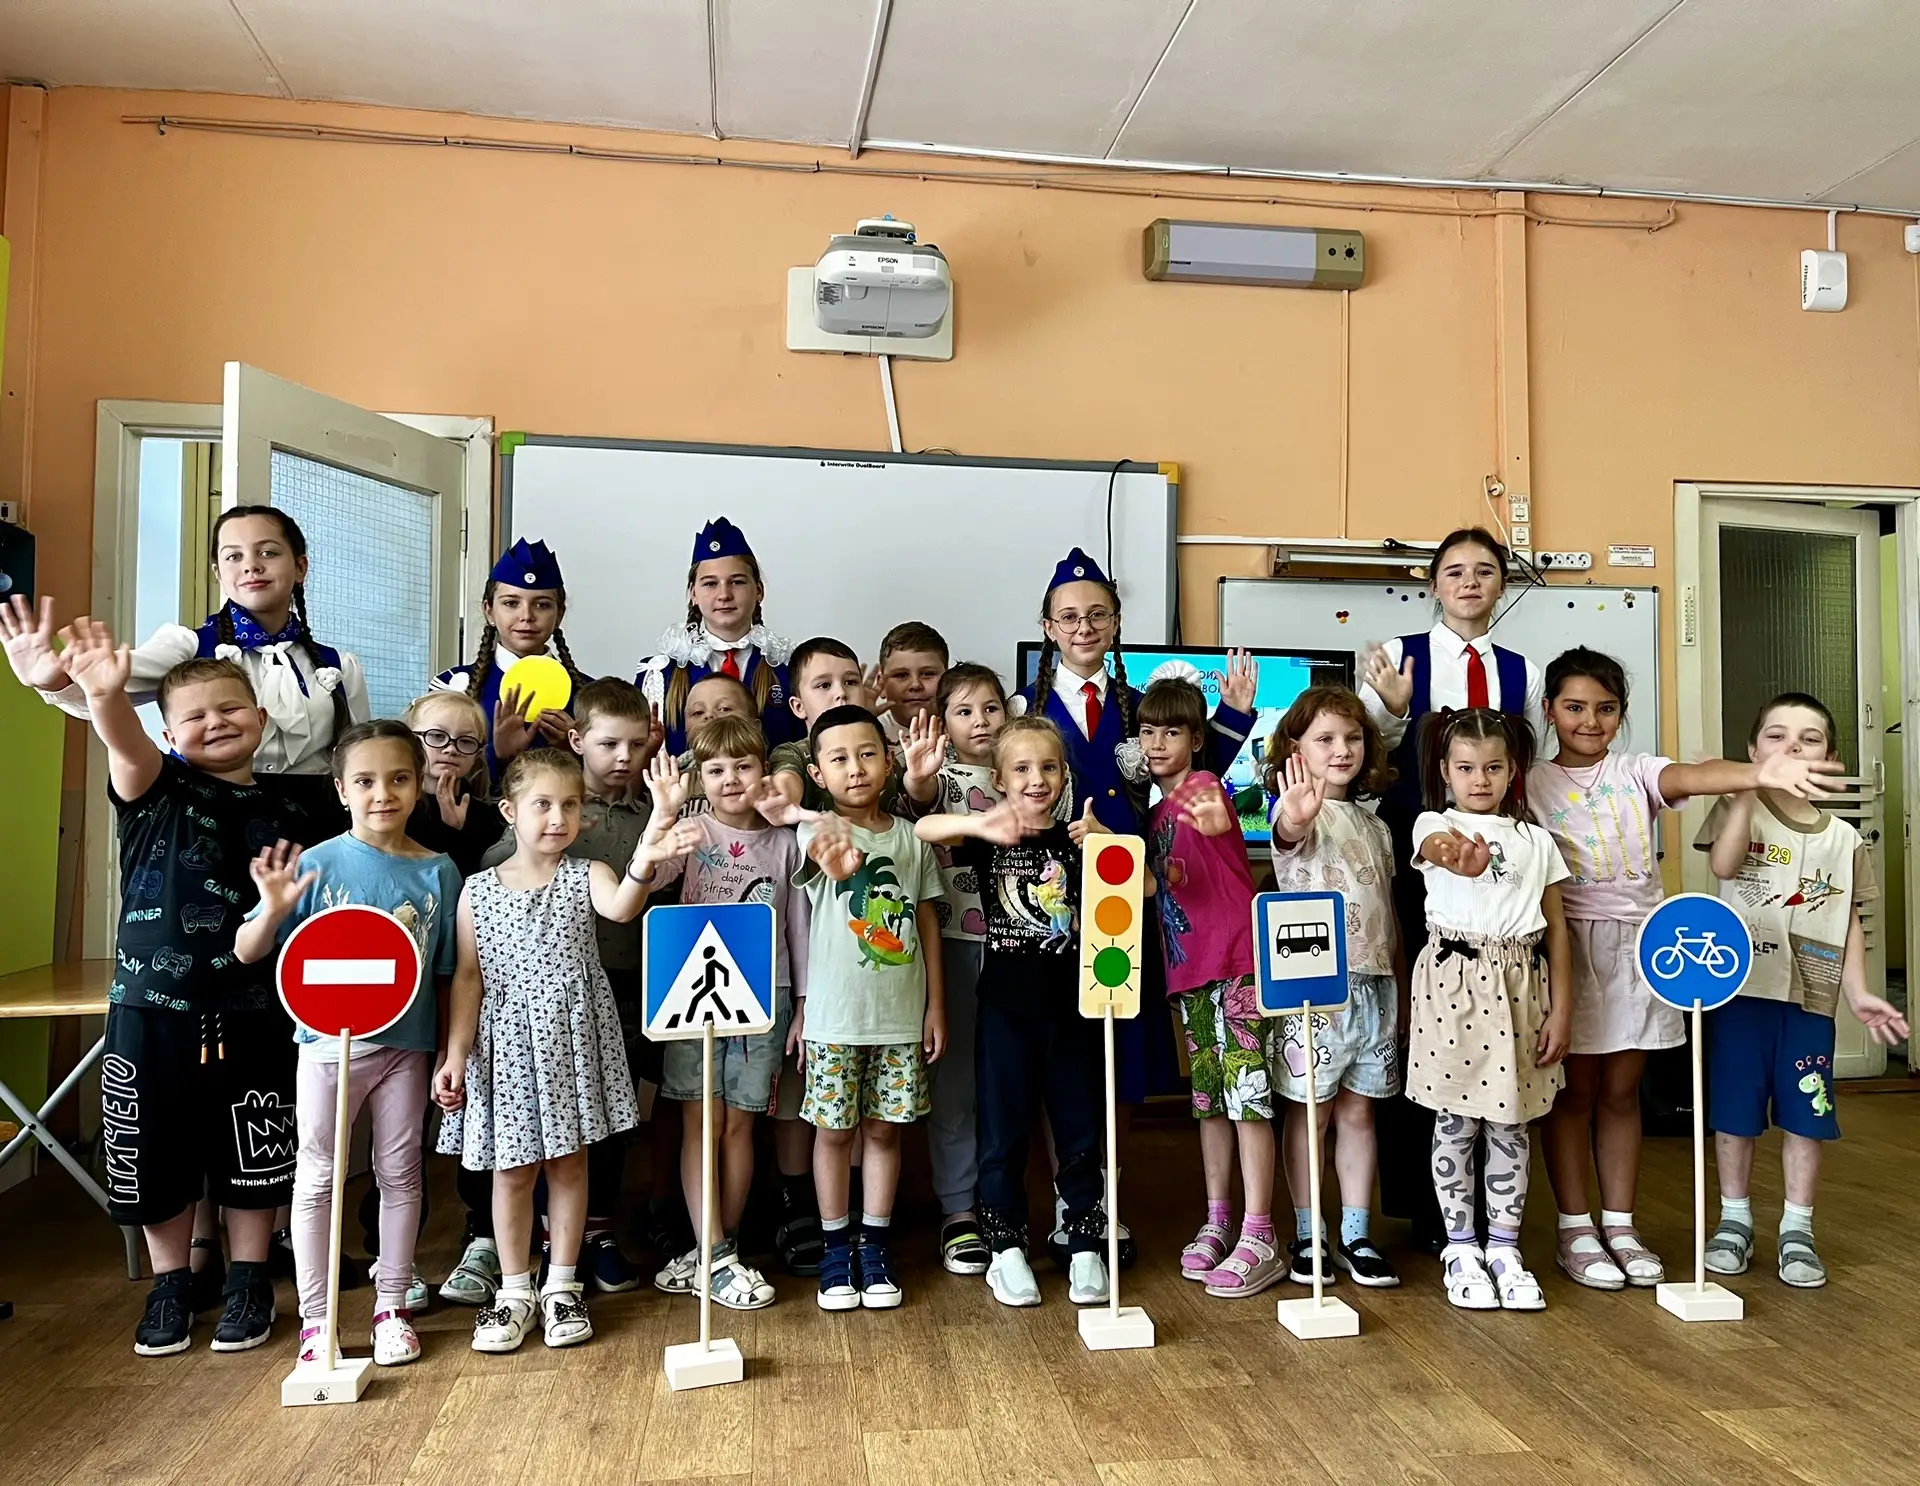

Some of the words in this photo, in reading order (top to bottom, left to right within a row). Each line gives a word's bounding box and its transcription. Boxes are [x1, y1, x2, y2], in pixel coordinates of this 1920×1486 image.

[877, 256, 899, 264] EPSON
[1767, 844, 1791, 865] 29
[714, 858, 729, 868] No
[732, 863, 757, 873] MORE
[203, 878, 241, 904] GAME
[125, 907, 162, 924] WINNER
[989, 926, 1008, 936] HAVE
[1009, 929, 1035, 938] NEVER
[1001, 938, 1020, 947] SEEN
[117, 948, 145, 976] PLAY
